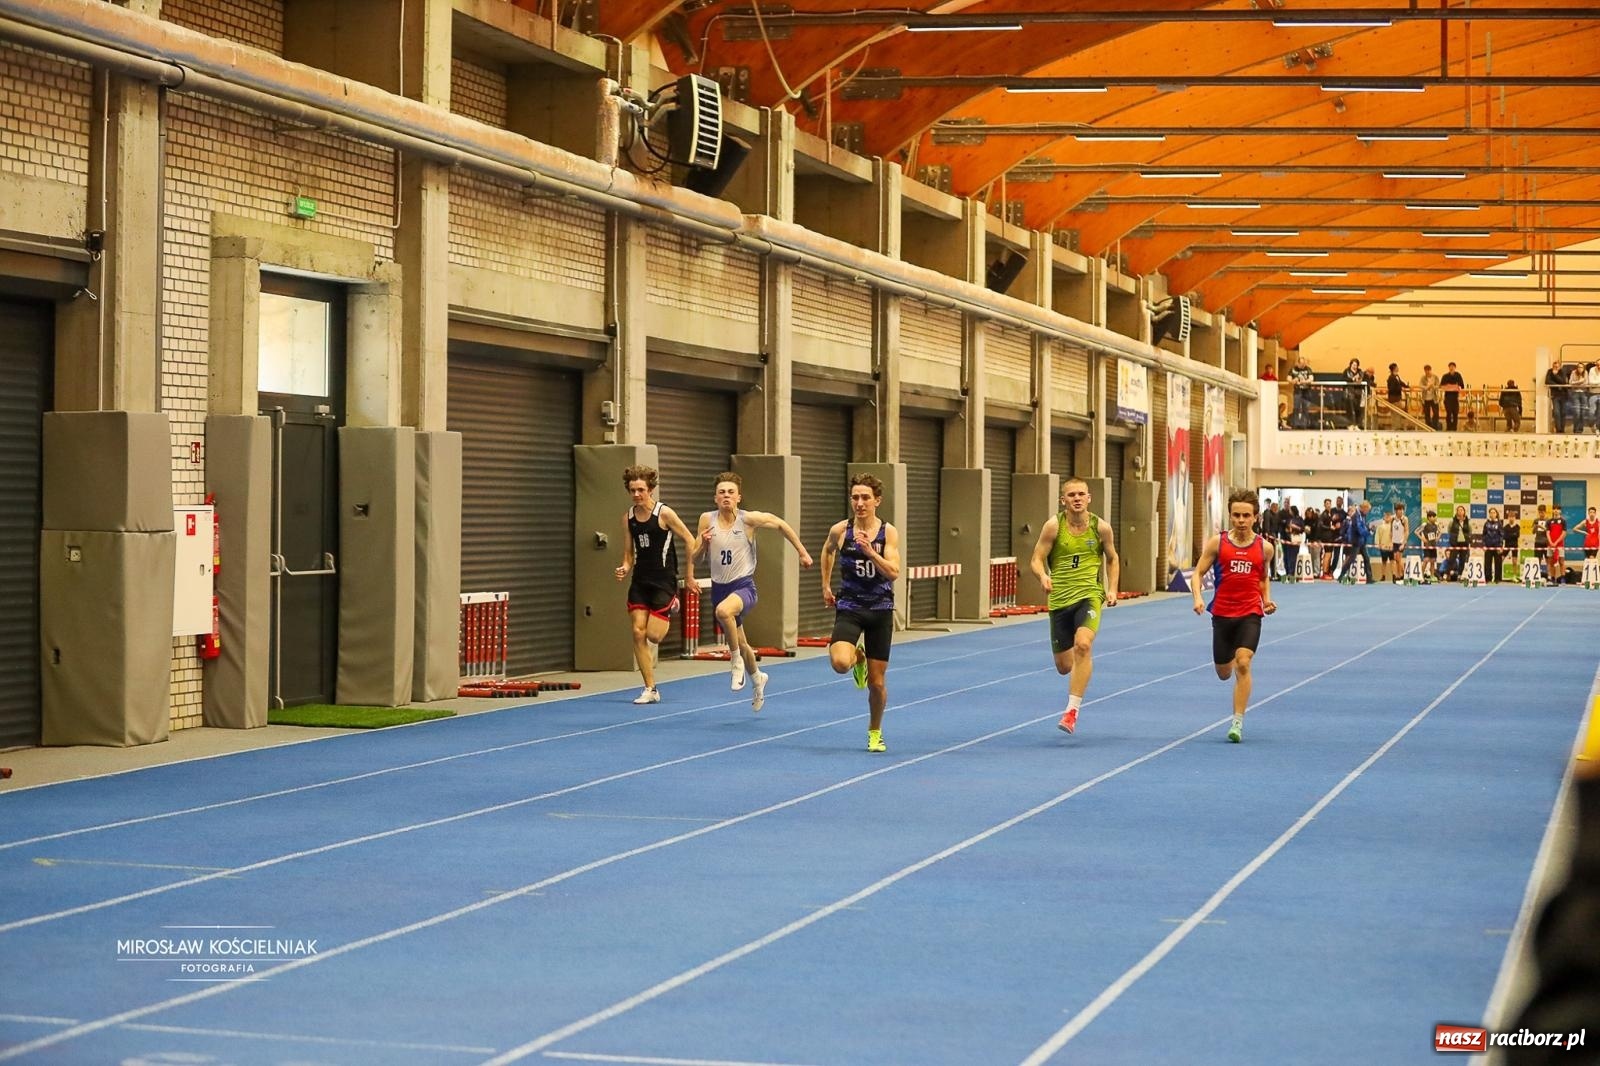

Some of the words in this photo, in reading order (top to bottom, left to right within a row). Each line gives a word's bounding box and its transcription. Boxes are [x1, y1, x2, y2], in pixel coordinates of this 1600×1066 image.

[720, 550, 732, 565] 26
[1072, 554, 1080, 568] 9
[855, 559, 876, 578] 50
[1230, 560, 1253, 574] 566
